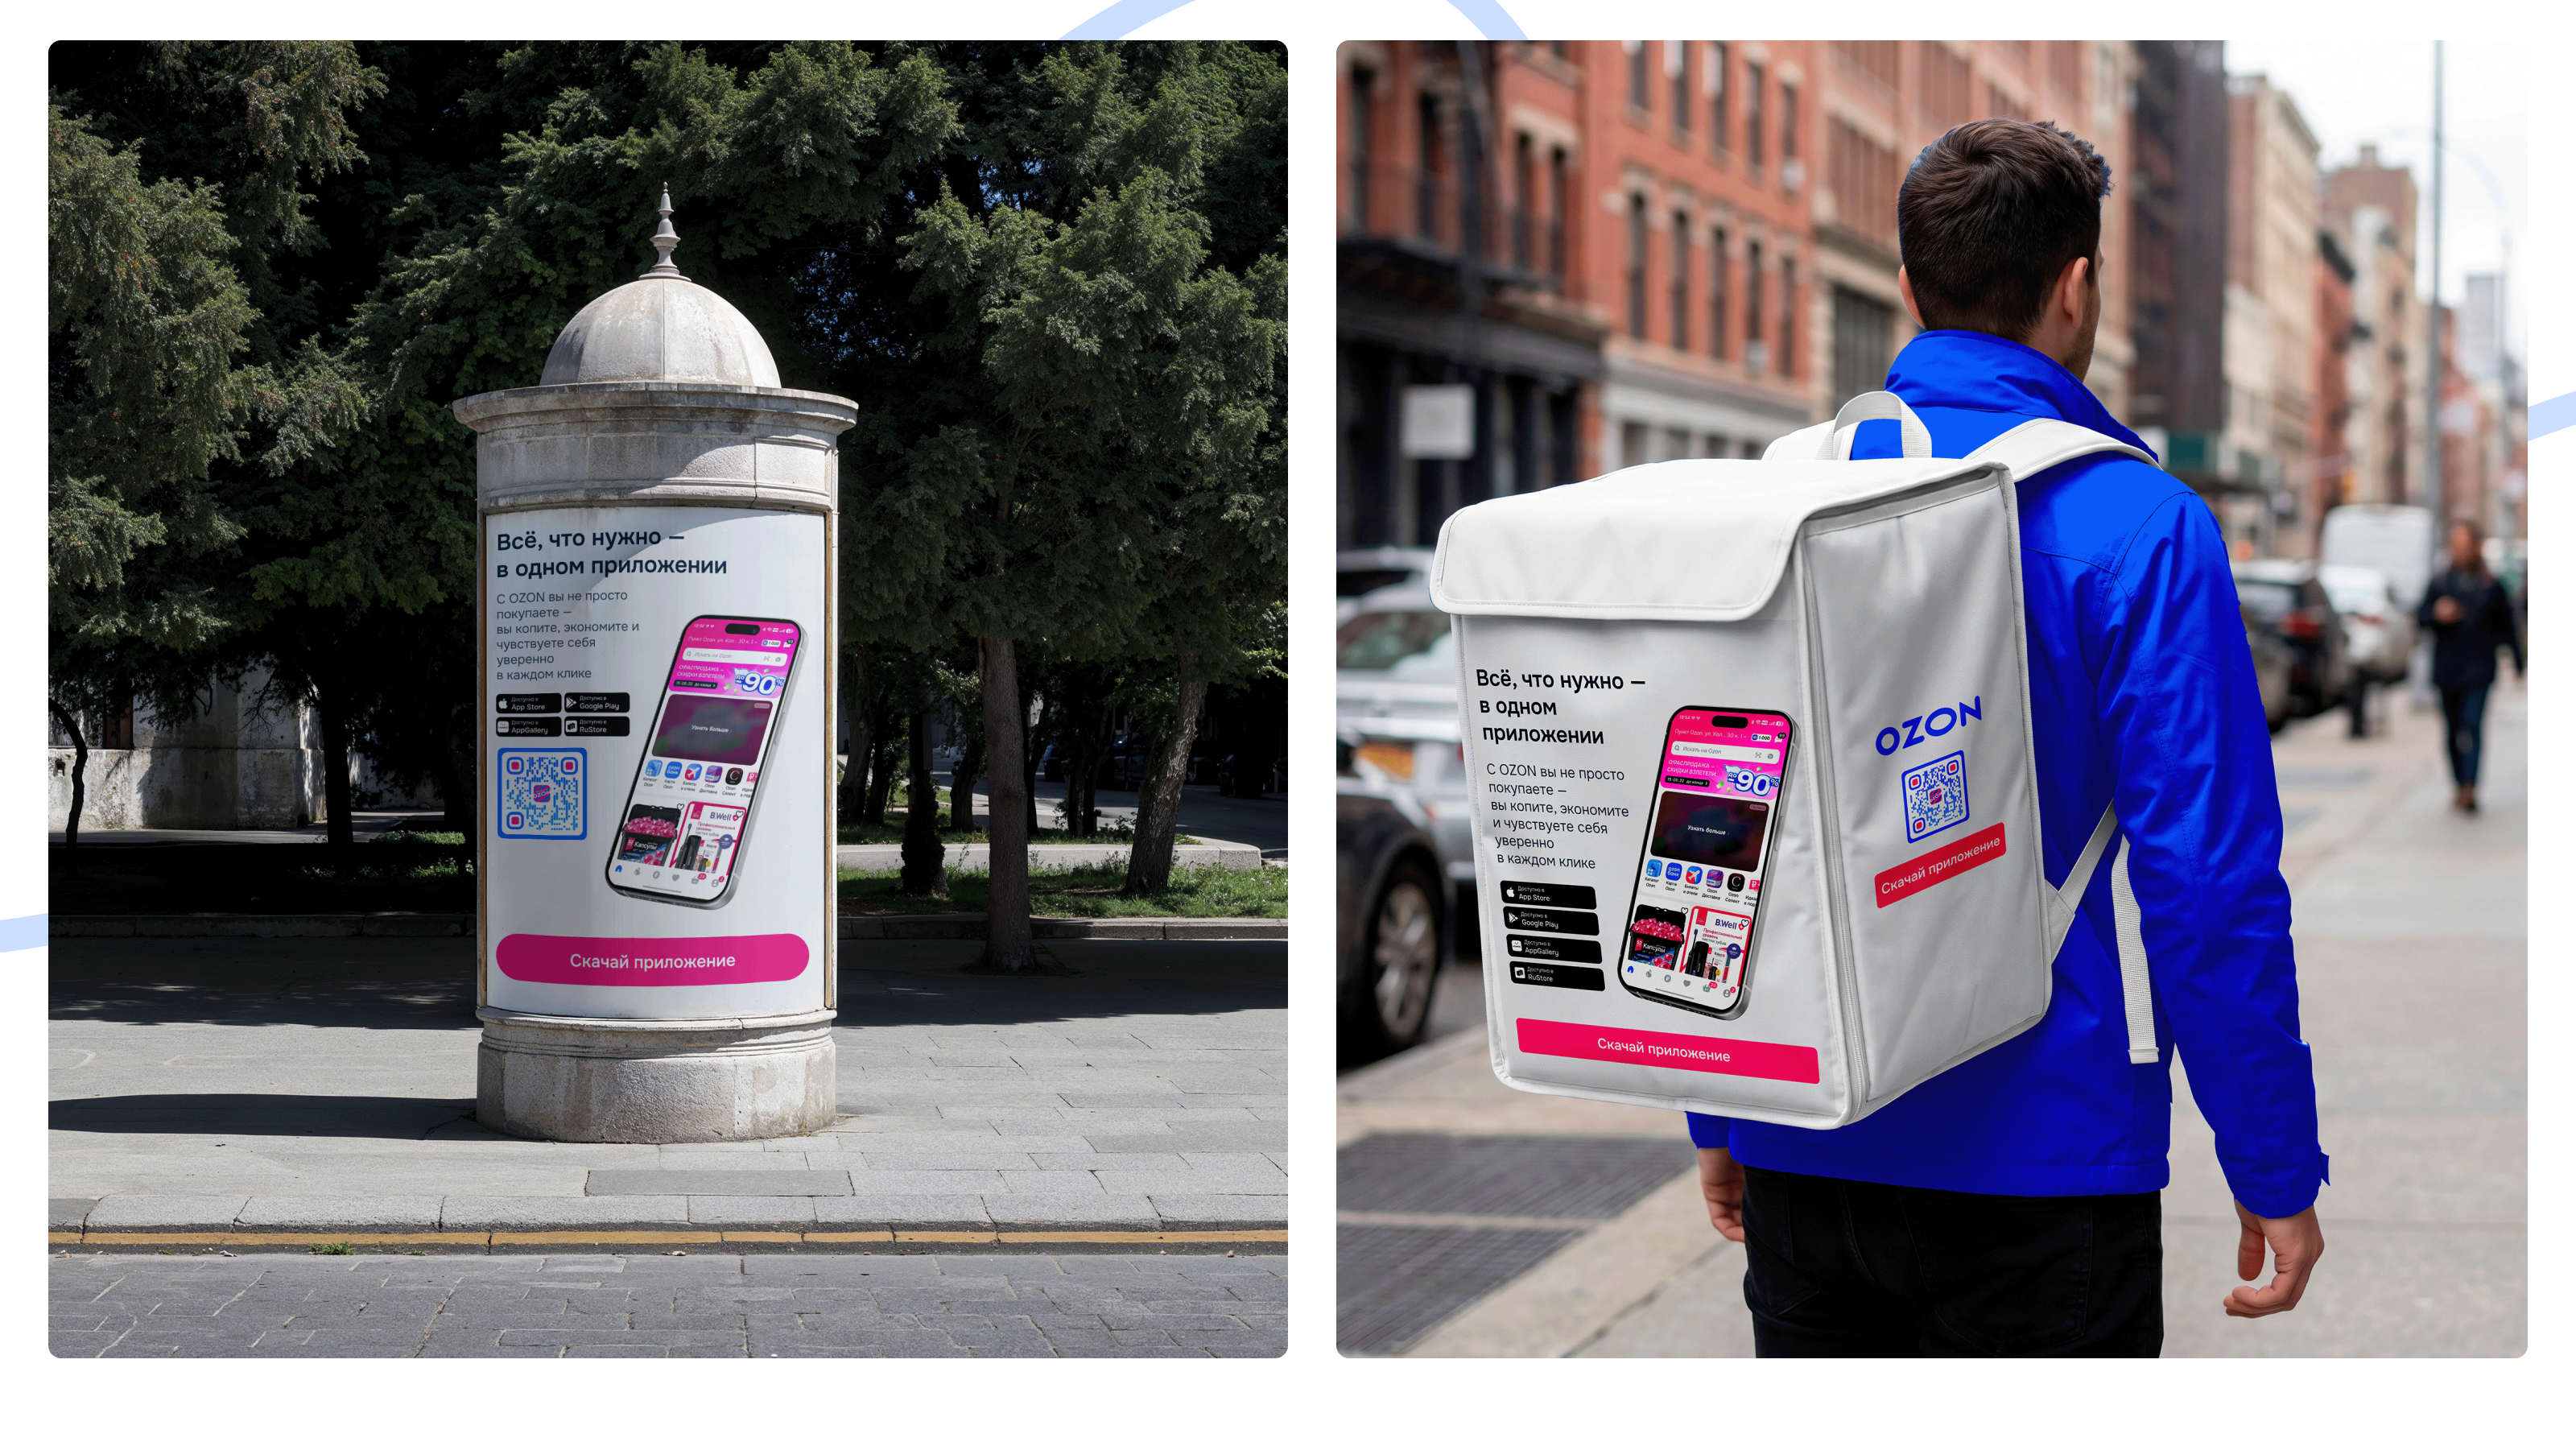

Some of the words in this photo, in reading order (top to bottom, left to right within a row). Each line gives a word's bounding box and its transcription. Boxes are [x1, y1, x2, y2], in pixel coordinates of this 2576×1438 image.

[497, 531, 543, 551] Всё,
[549, 533, 584, 547] что
[592, 531, 661, 551] нужно
[497, 565, 509, 577] в
[516, 561, 584, 579] одном
[592, 560, 726, 577] приложении
[497, 594, 506, 604] С
[509, 592, 545, 603] OZON
[568, 593, 581, 601] не
[585, 592, 627, 602] просто
[497, 609, 559, 621] покупаете
[516, 625, 560, 634] копите,
[564, 623, 628, 632] экономите
[632, 623, 639, 631] и
[497, 640, 564, 651] чувствуете
[568, 638, 596, 647] себя
[497, 655, 554, 667] уверенно
[497, 671, 503, 680] в
[507, 671, 554, 681] каждом
[557, 670, 592, 678] клике
[1476, 669, 1517, 690] Всё,
[1521, 674, 1554, 688] что
[1560, 675, 1624, 693] нужно
[1480, 700, 1490, 713] в
[1496, 700, 1557, 717] одном
[1875, 696, 1982, 756] OZON
[1483, 727, 1604, 744] приложении
[1487, 763, 1496, 775] С
[1500, 764, 1536, 776] OZON
[1541, 768, 1556, 777] вы
[1560, 769, 1575, 778] не
[1579, 770, 1624, 782] просто
[1489, 783, 1554, 796] покупаете
[1491, 801, 1507, 811] вы
[1510, 803, 1557, 815] копите,
[1560, 804, 1629, 816] экономите
[710, 812, 732, 820] B.Well
[1493, 819, 1501, 828] и
[1504, 820, 1574, 833] чувствуете
[1578, 822, 1608, 833] себя
[1687, 824, 1704, 833] Узнать
[1495, 837, 1554, 849] уверенно
[1497, 854, 1504, 863] в
[1508, 855, 1555, 867] каждом
[1559, 858, 1596, 869] клике
[1881, 868, 1926, 895] Скачай
[1929, 837, 2000, 874] приложение
[1521, 919, 1544, 928] Google
[1545, 921, 1558, 929] Play
[1715, 919, 1737, 929] B.Well
[1525, 947, 1558, 957] AppGallery
[1643, 943, 1666, 952] Капсулы
[570, 954, 629, 969] Скачай
[634, 957, 736, 972] приложение
[1598, 1038, 1644, 1053] Скачай
[1649, 1046, 1730, 1062] приложение
